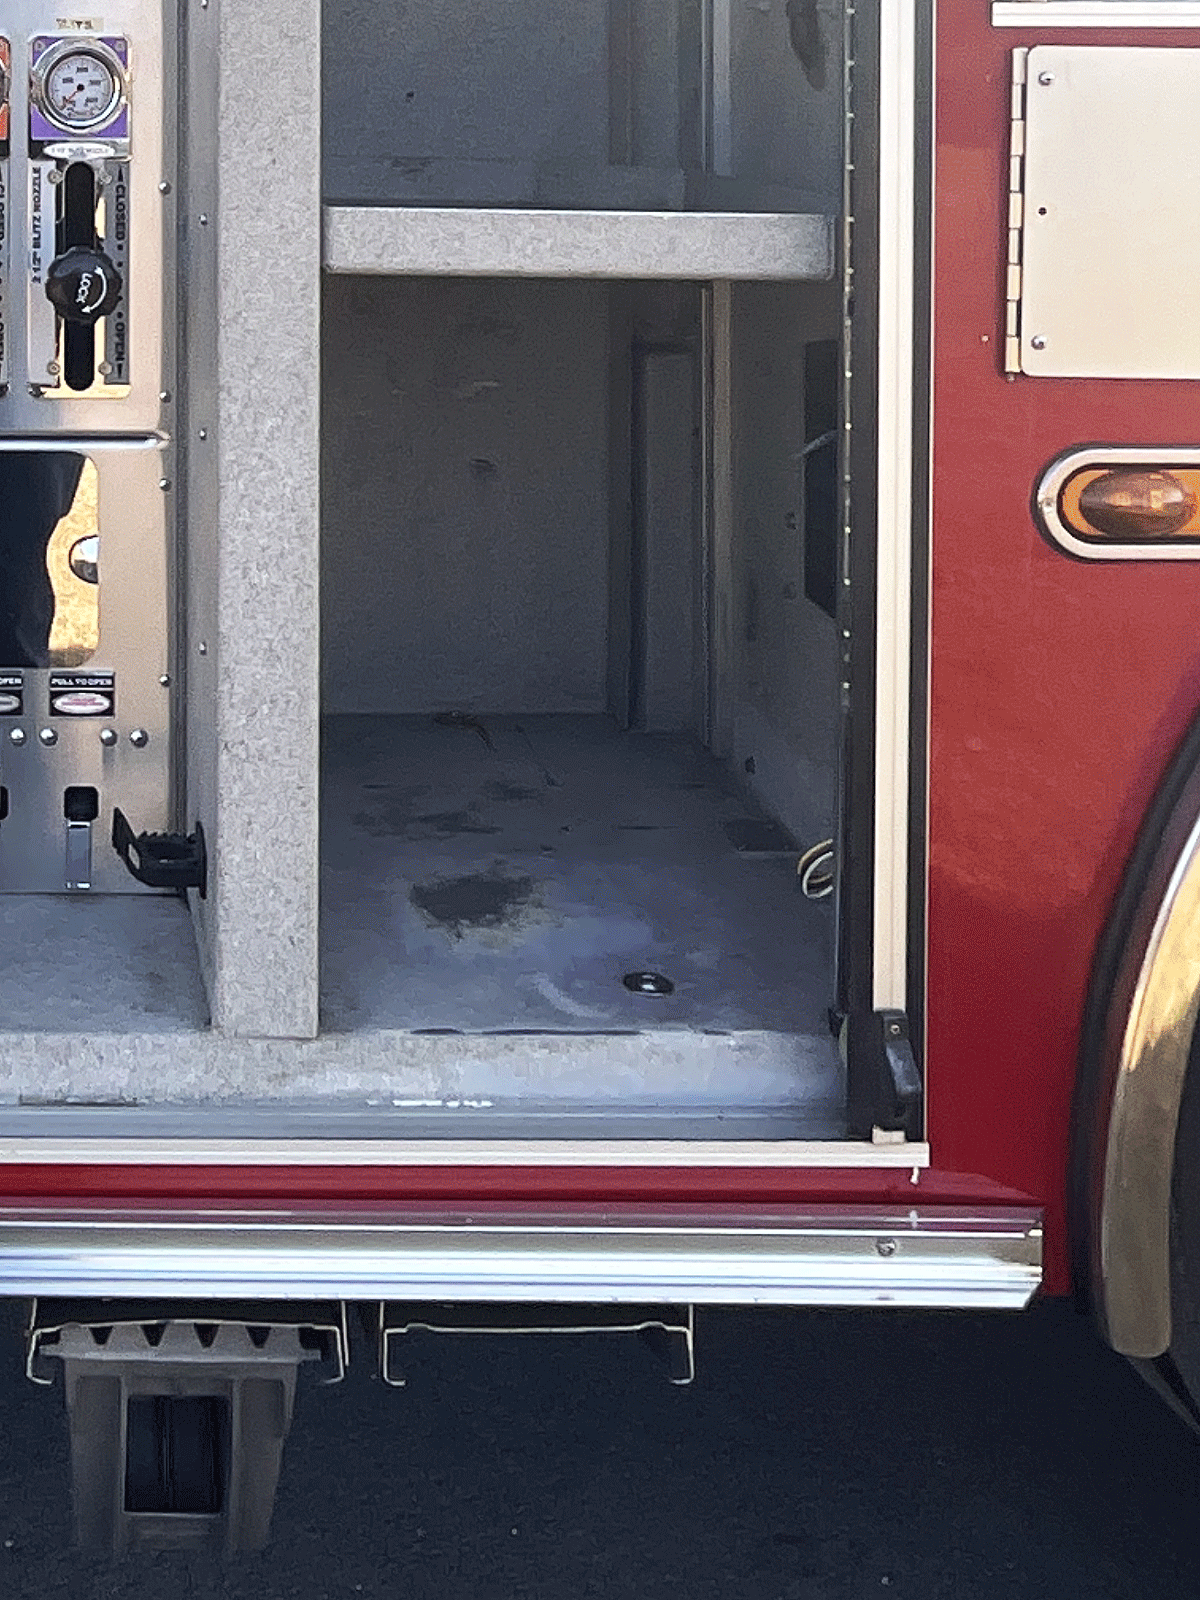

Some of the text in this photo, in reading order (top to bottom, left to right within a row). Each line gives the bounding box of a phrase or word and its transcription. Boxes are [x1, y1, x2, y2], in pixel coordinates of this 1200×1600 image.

[32, 167, 41, 213] NOZZLE
[115, 185, 126, 240] CLOSED
[32, 215, 41, 249] BLITZ
[76, 273, 93, 303] LOCK
[115, 322, 125, 362] OPEN
[51, 678, 112, 686] PULL TO OPEN
